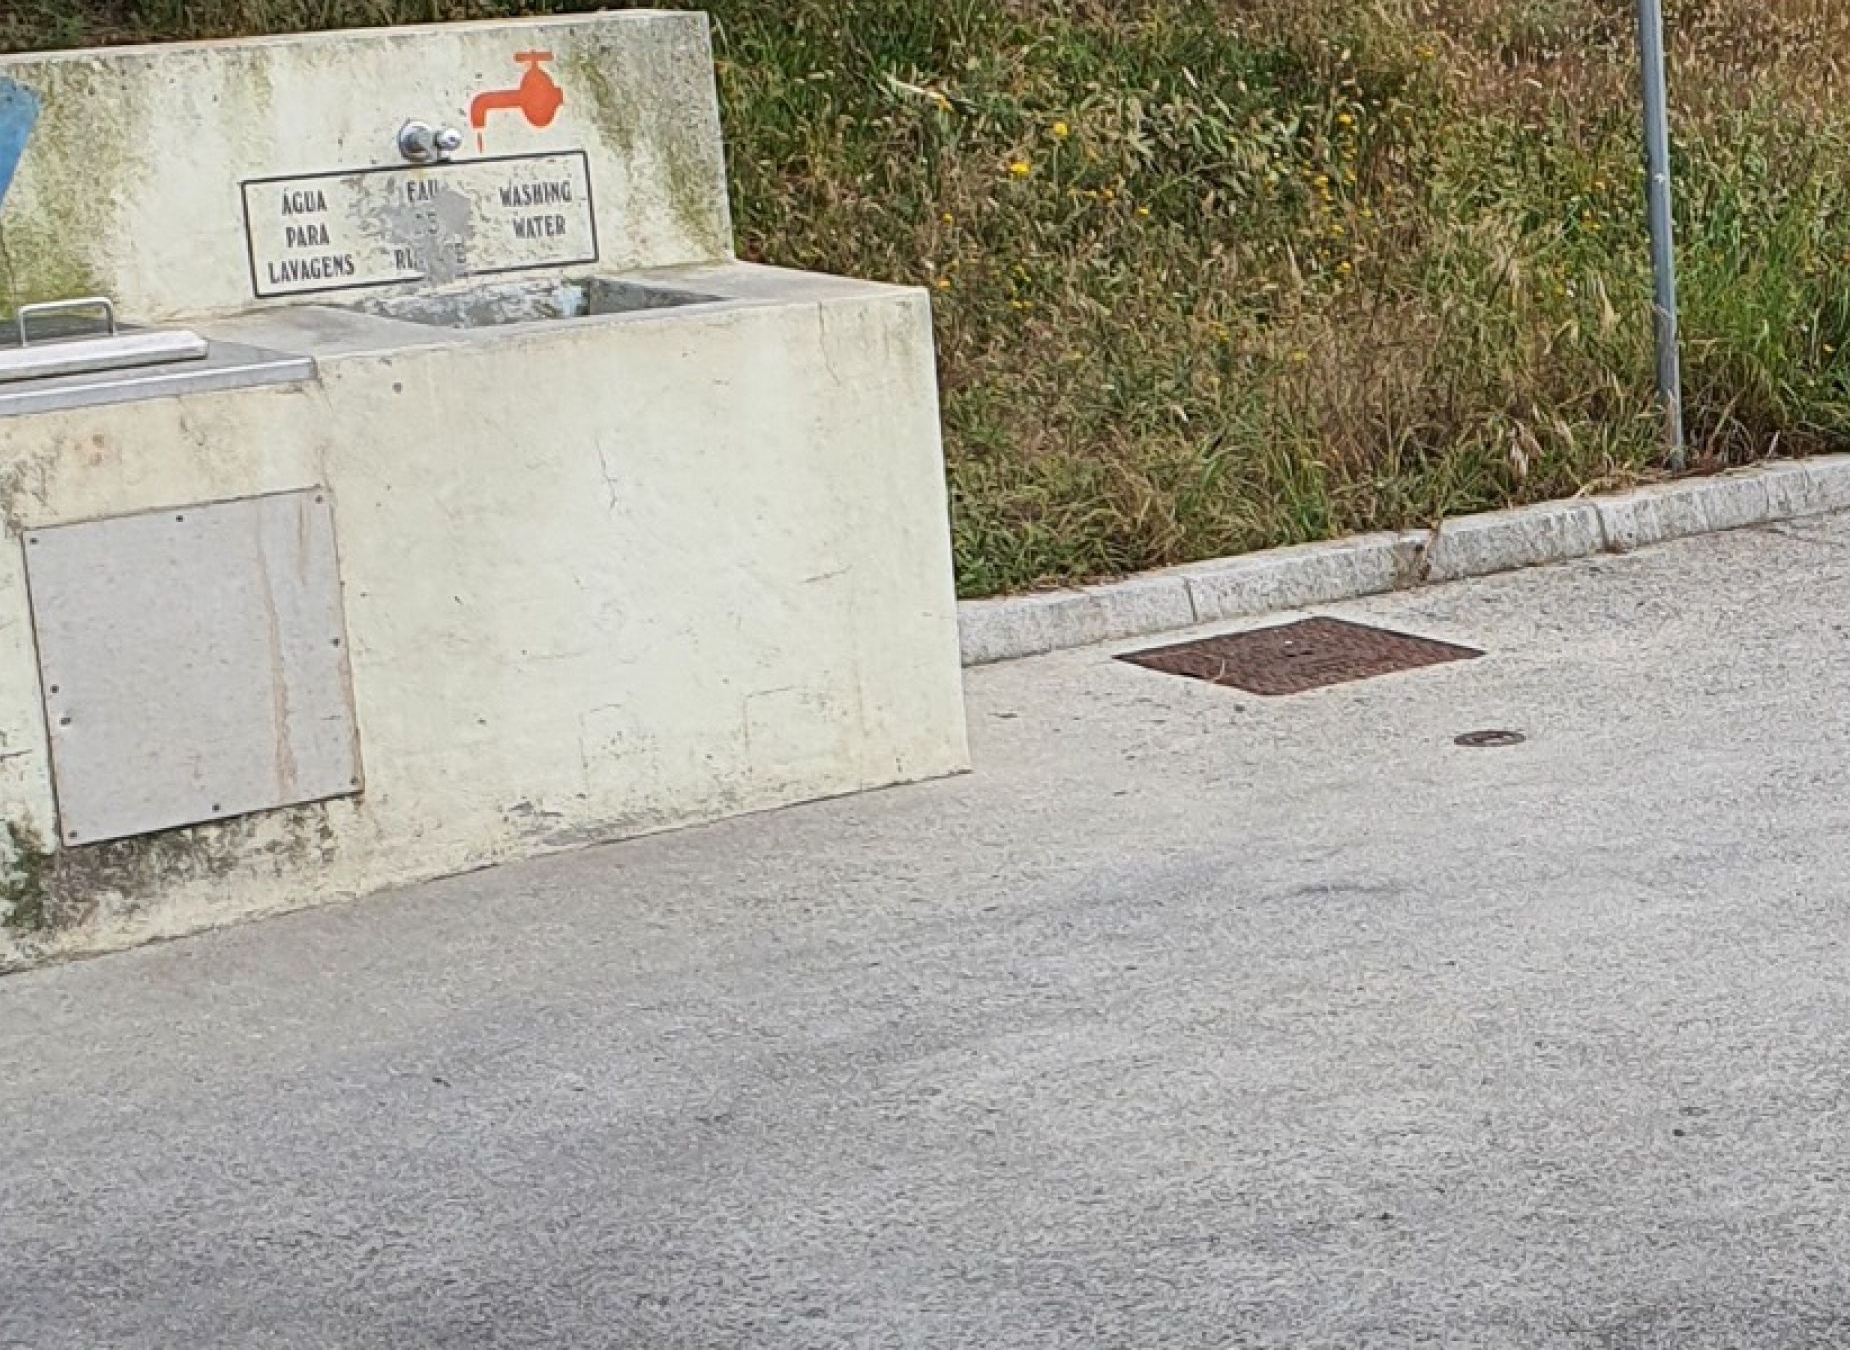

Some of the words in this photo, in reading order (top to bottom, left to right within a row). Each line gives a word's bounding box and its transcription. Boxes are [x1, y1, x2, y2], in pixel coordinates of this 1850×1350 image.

[498, 178, 573, 205] WASHING
[285, 222, 330, 249] PARA
[512, 215, 566, 240] WATER
[267, 253, 355, 285] LAVAGENS
